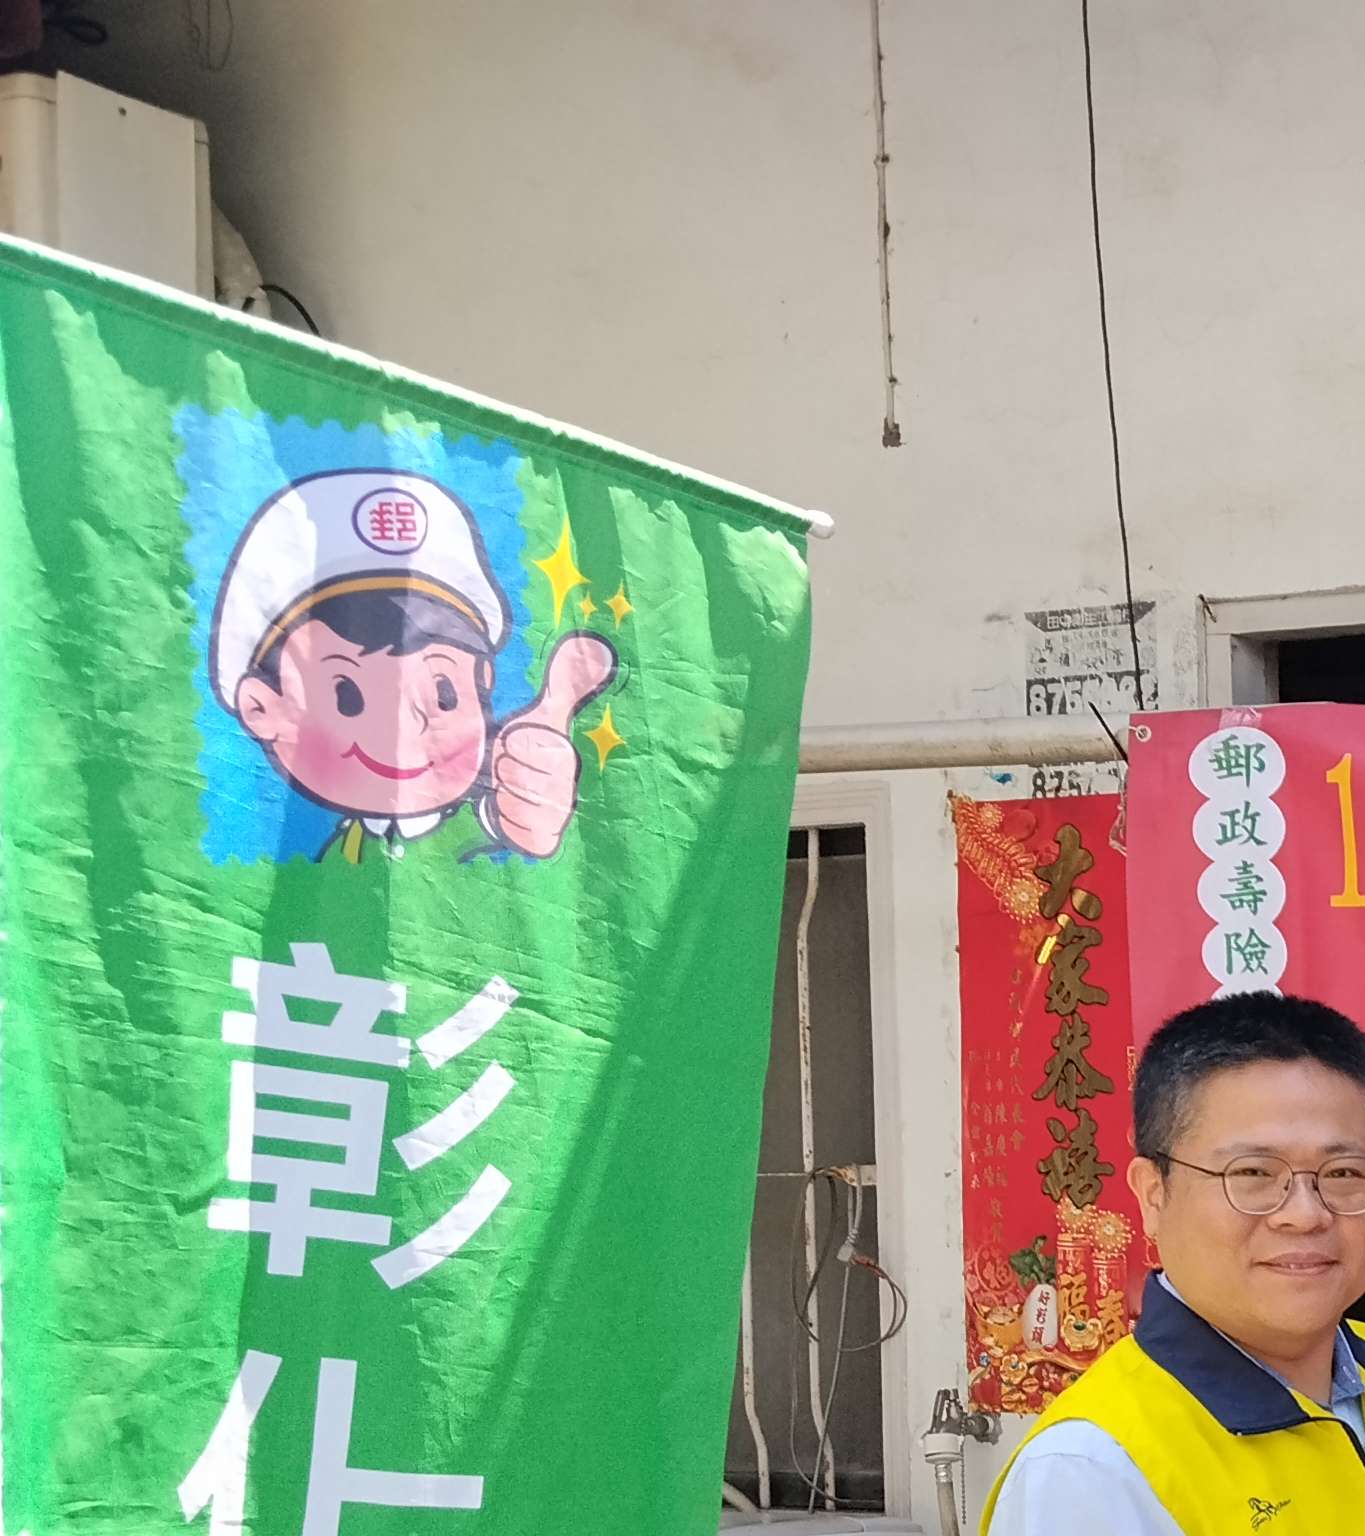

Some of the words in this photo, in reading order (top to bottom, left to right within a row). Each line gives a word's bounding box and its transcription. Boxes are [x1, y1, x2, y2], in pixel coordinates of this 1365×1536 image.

[369, 501, 418, 543] 郵
[1210, 733, 1271, 978] 郵政壽險
